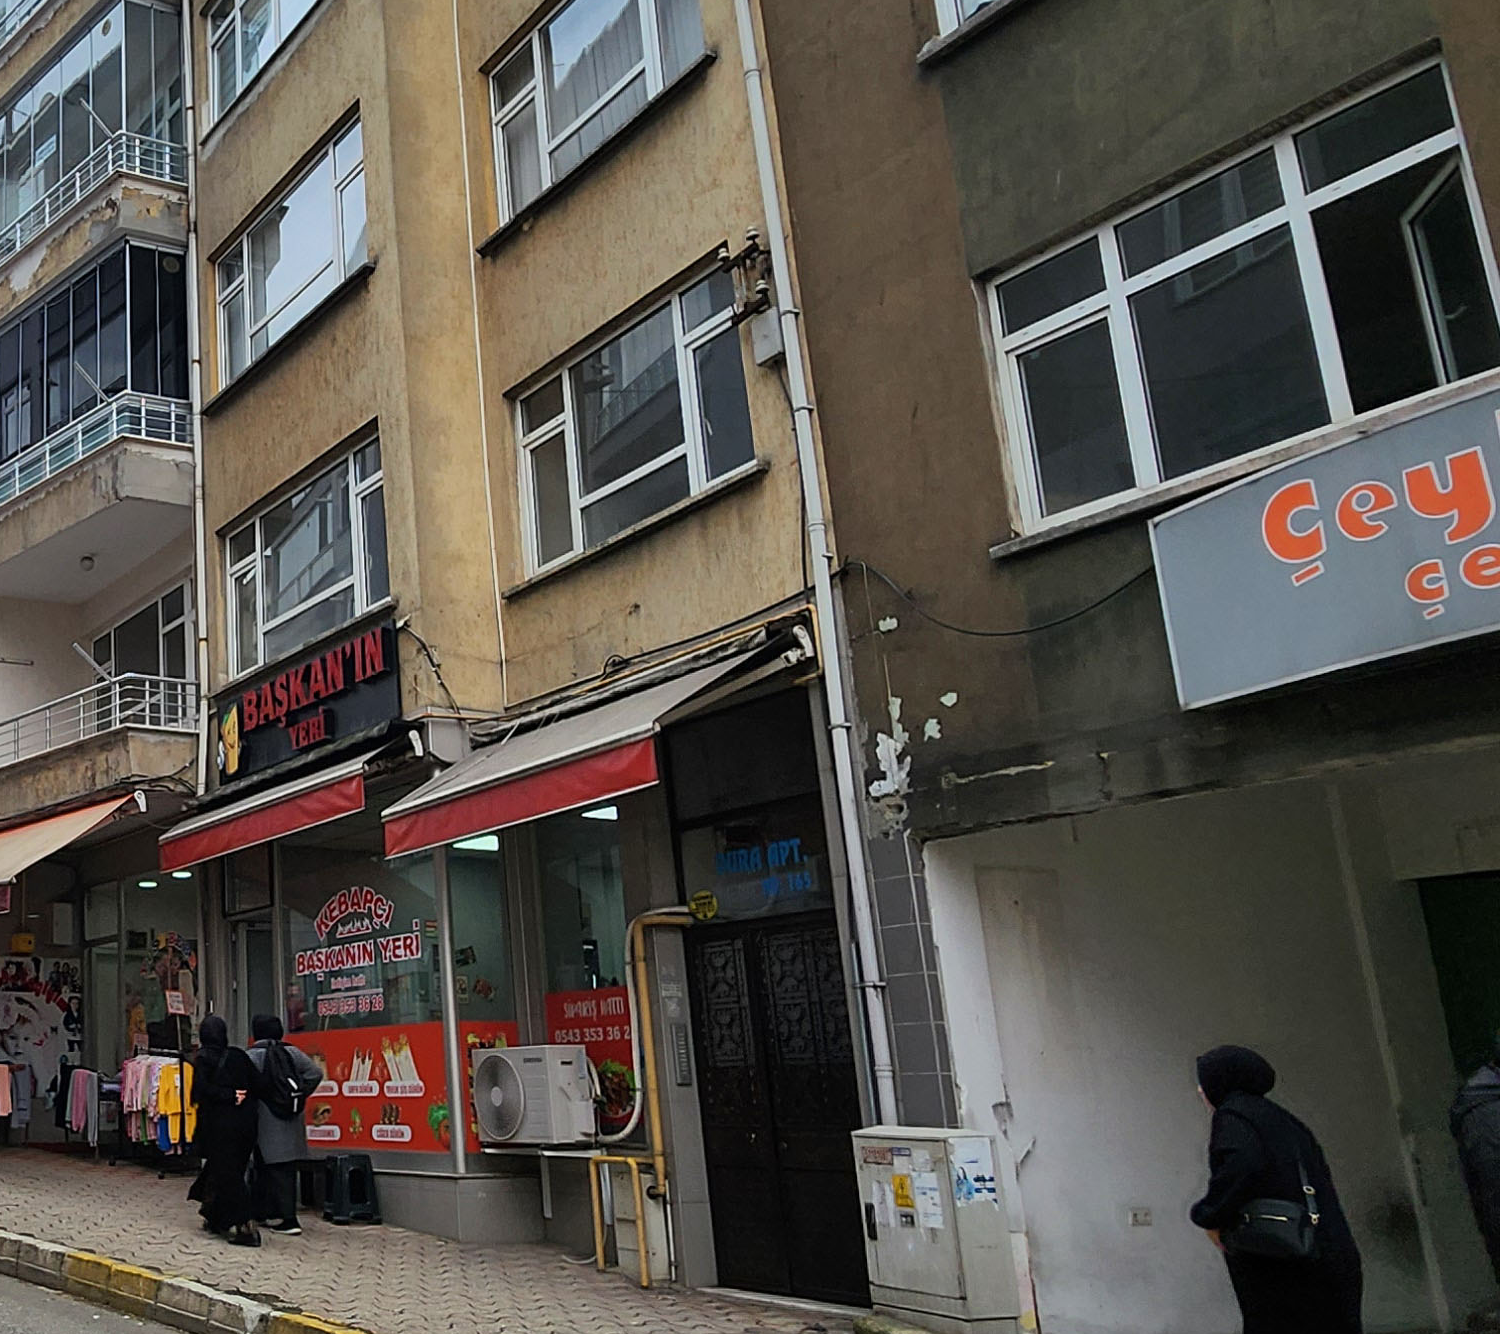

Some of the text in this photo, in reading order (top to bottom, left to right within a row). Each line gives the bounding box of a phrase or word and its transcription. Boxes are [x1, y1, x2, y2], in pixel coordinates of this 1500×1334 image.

[242, 627, 385, 732] BAŞKAN'IN
[289, 705, 325, 750] YERİ
[314, 886, 395, 941] KEBAPÇI
[296, 919, 422, 981] BAŞKANIN YERİ
[358, 995, 370, 1012] 36
[371, 994, 384, 1011] 28
[563, 997, 625, 1022] SİPARİŞ HATTI
[554, 1026, 631, 1043] 0543 353 36 2
